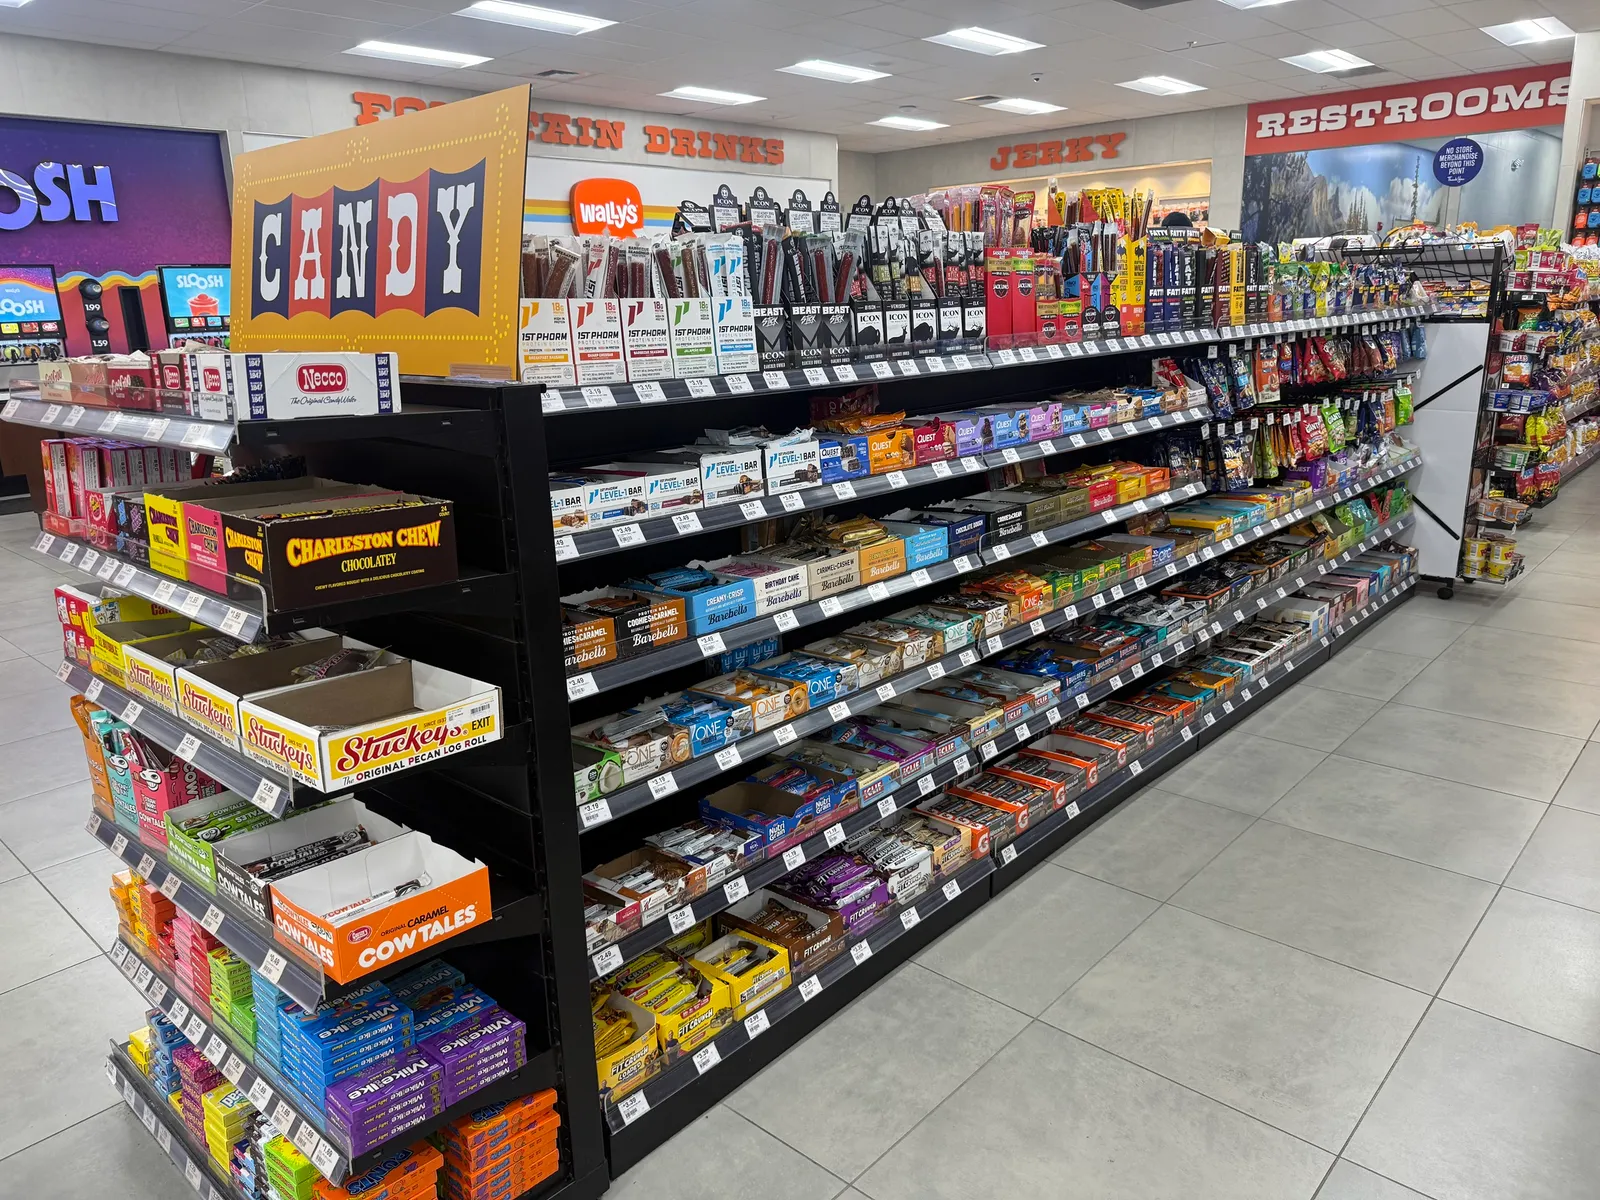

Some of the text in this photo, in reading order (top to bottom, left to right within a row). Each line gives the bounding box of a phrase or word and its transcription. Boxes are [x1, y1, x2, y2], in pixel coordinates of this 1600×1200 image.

[1255, 76, 1570, 139] RESTROOMS
[645, 130, 785, 167] DRINKS
[991, 131, 1126, 171] JERKY
[1439, 152, 1478, 162] MERCHANDISE
[1455, 145, 1473, 154] STORE
[1440, 159, 1476, 169] BEYOND THIS
[1448, 167, 1465, 175] POINT
[259, 182, 476, 302] CANDY
[177, 273, 224, 290] SLOOSH
[85, 303, 101, 312] 1.99
[753, 306, 784, 317] BEAST
[792, 306, 820, 315] BEAST
[823, 305, 850, 315] BEAST
[889, 312, 908, 321] ICON
[915, 311, 934, 320] ICON
[942, 309, 960, 317] ICON
[967, 309, 983, 317] ICON
[860, 315, 880, 323] ICON
[522, 332, 567, 341] 1ST PHORM
[590, 331, 619, 339] PHORM
[641, 328, 667, 336] PHORM
[92, 339, 108, 348] 1.59
[302, 368, 343, 390] Necco
[957, 427, 976, 438] QUEST
[995, 421, 1013, 431] QUEST
[871, 440, 893, 451] QUEST
[916, 433, 937, 444] QUEST
[779, 451, 816, 465] LEVEL-1 BAR
[716, 460, 758, 475] LEVEL-1 BAR
[600, 485, 642, 500] LEVEL-1 BAR
[660, 476, 698, 491] LEVEL-1 BAR
[149, 506, 179, 529] CHARLESTON
[188, 517, 218, 539] CHARLESTON
[225, 527, 263, 552] CHARLESTON
[286, 519, 442, 568] CHARLESTON CHEW
[244, 551, 264, 576] CHEW
[341, 552, 397, 573] CHOCOLATEY
[871, 560, 900, 577] Barebells
[764, 572, 800, 590] BIRTHDAY CAKE
[821, 573, 854, 591] Barebells
[766, 588, 802, 607] Barebells
[707, 604, 748, 625] Barebells
[632, 624, 678, 647] Barebells
[129, 656, 172, 702] Stuckey's
[861, 664, 881, 678] ONE
[809, 677, 832, 695] ONE
[182, 682, 235, 734] Stuckey's
[757, 696, 781, 716] ONE
[471, 716, 491, 732] EXIT
[695, 721, 723, 742] ONE
[247, 718, 314, 772] Stuckey's
[338, 724, 463, 772] Stuckey's
[626, 744, 656, 764] ONE
[356, 760, 406, 783] ORIGINAL
[408, 749, 441, 767] PECAN
[443, 743, 463, 757] LOG
[464, 736, 488, 751] ROLL
[815, 795, 831, 807] Nutri
[815, 801, 831, 814] Grain
[769, 821, 785, 834] Nutri
[769, 828, 786, 842] Grain
[380, 905, 449, 938] ORIGINAL CARAMEL
[850, 902, 877, 923] FIT CRUNCH
[358, 904, 477, 969] COW TALES
[318, 1002, 399, 1039] Mike Ike
[678, 1009, 713, 1037] FIT CRUNCH
[440, 1016, 513, 1054] Mike Ike
[611, 1046, 649, 1076] FIT CRUNCH
[348, 1059, 429, 1101] Mike Ike
[346, 1148, 414, 1195] RUNTS
